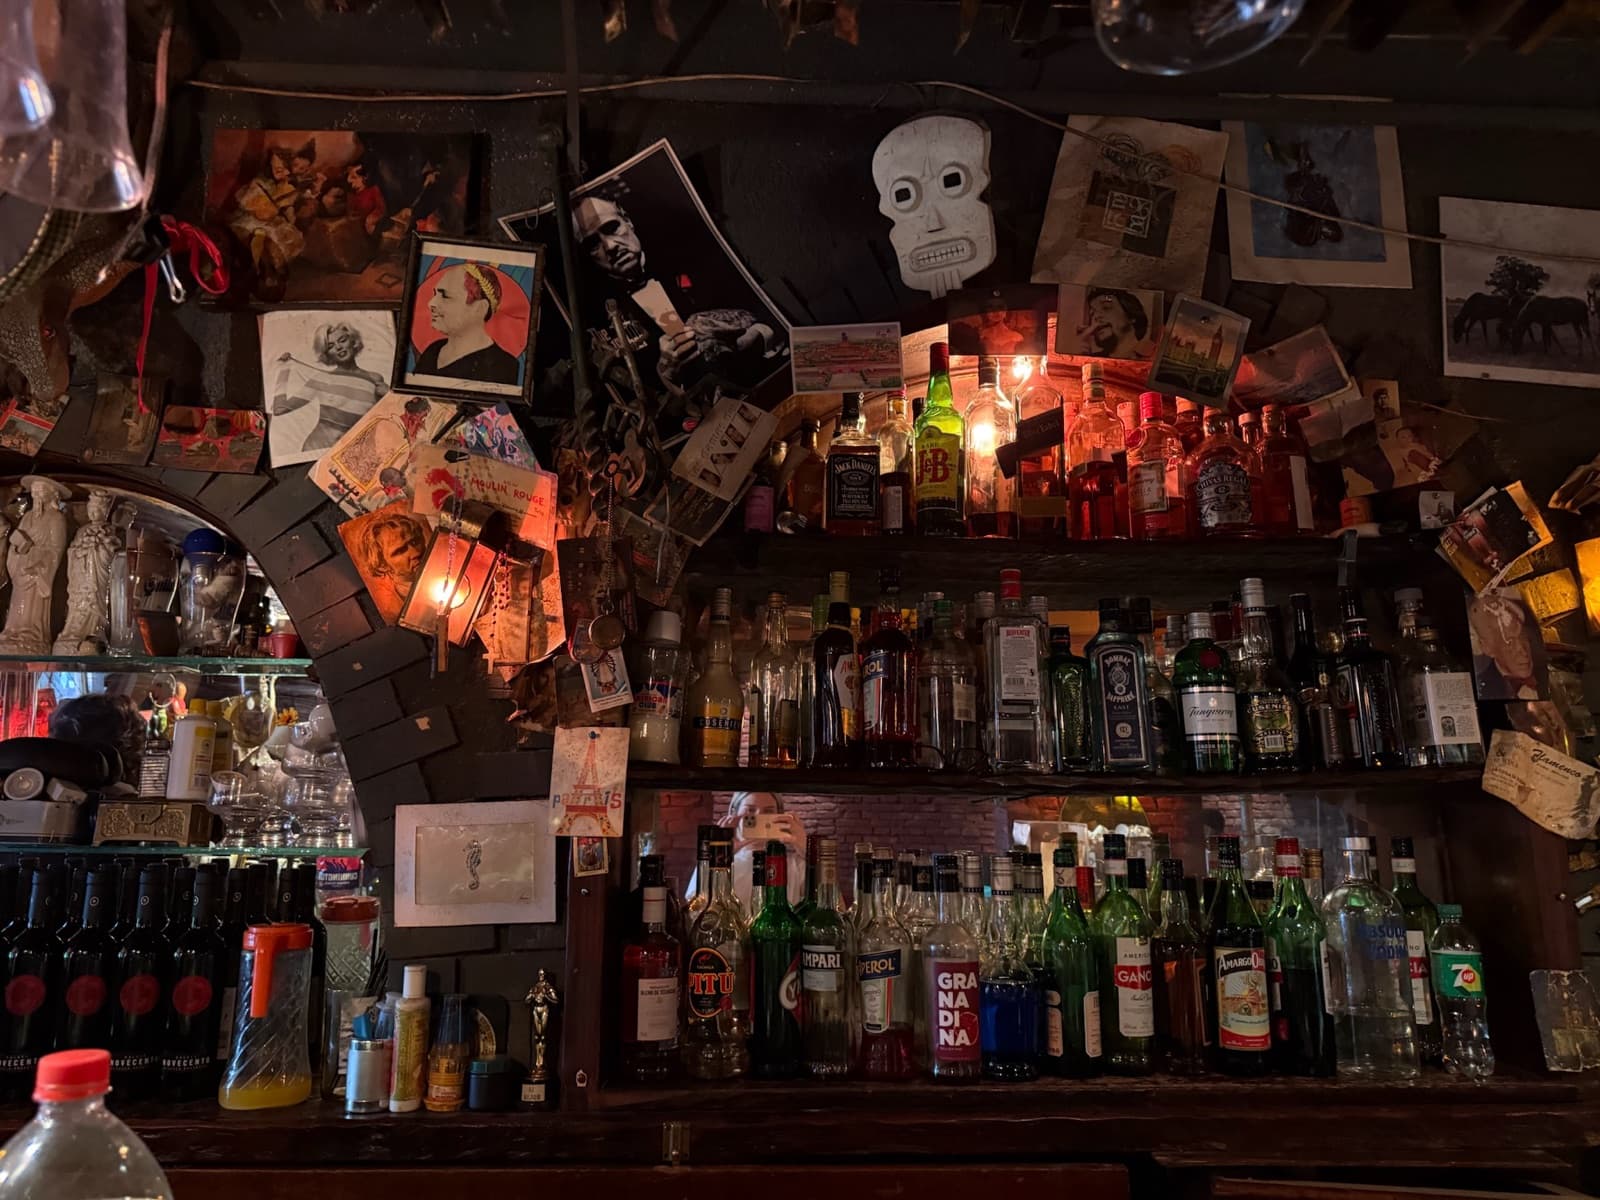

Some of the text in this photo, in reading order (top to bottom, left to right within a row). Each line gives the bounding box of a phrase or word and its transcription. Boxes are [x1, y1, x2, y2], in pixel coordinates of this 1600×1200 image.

[470, 477, 545, 507] MOULIN ROUGE
[1530, 747, 1582, 779] Flamenco
[936, 972, 978, 990] GRA
[937, 991, 970, 1009] NA
[938, 1009, 961, 1028] DI
[938, 1028, 971, 1047] NA
